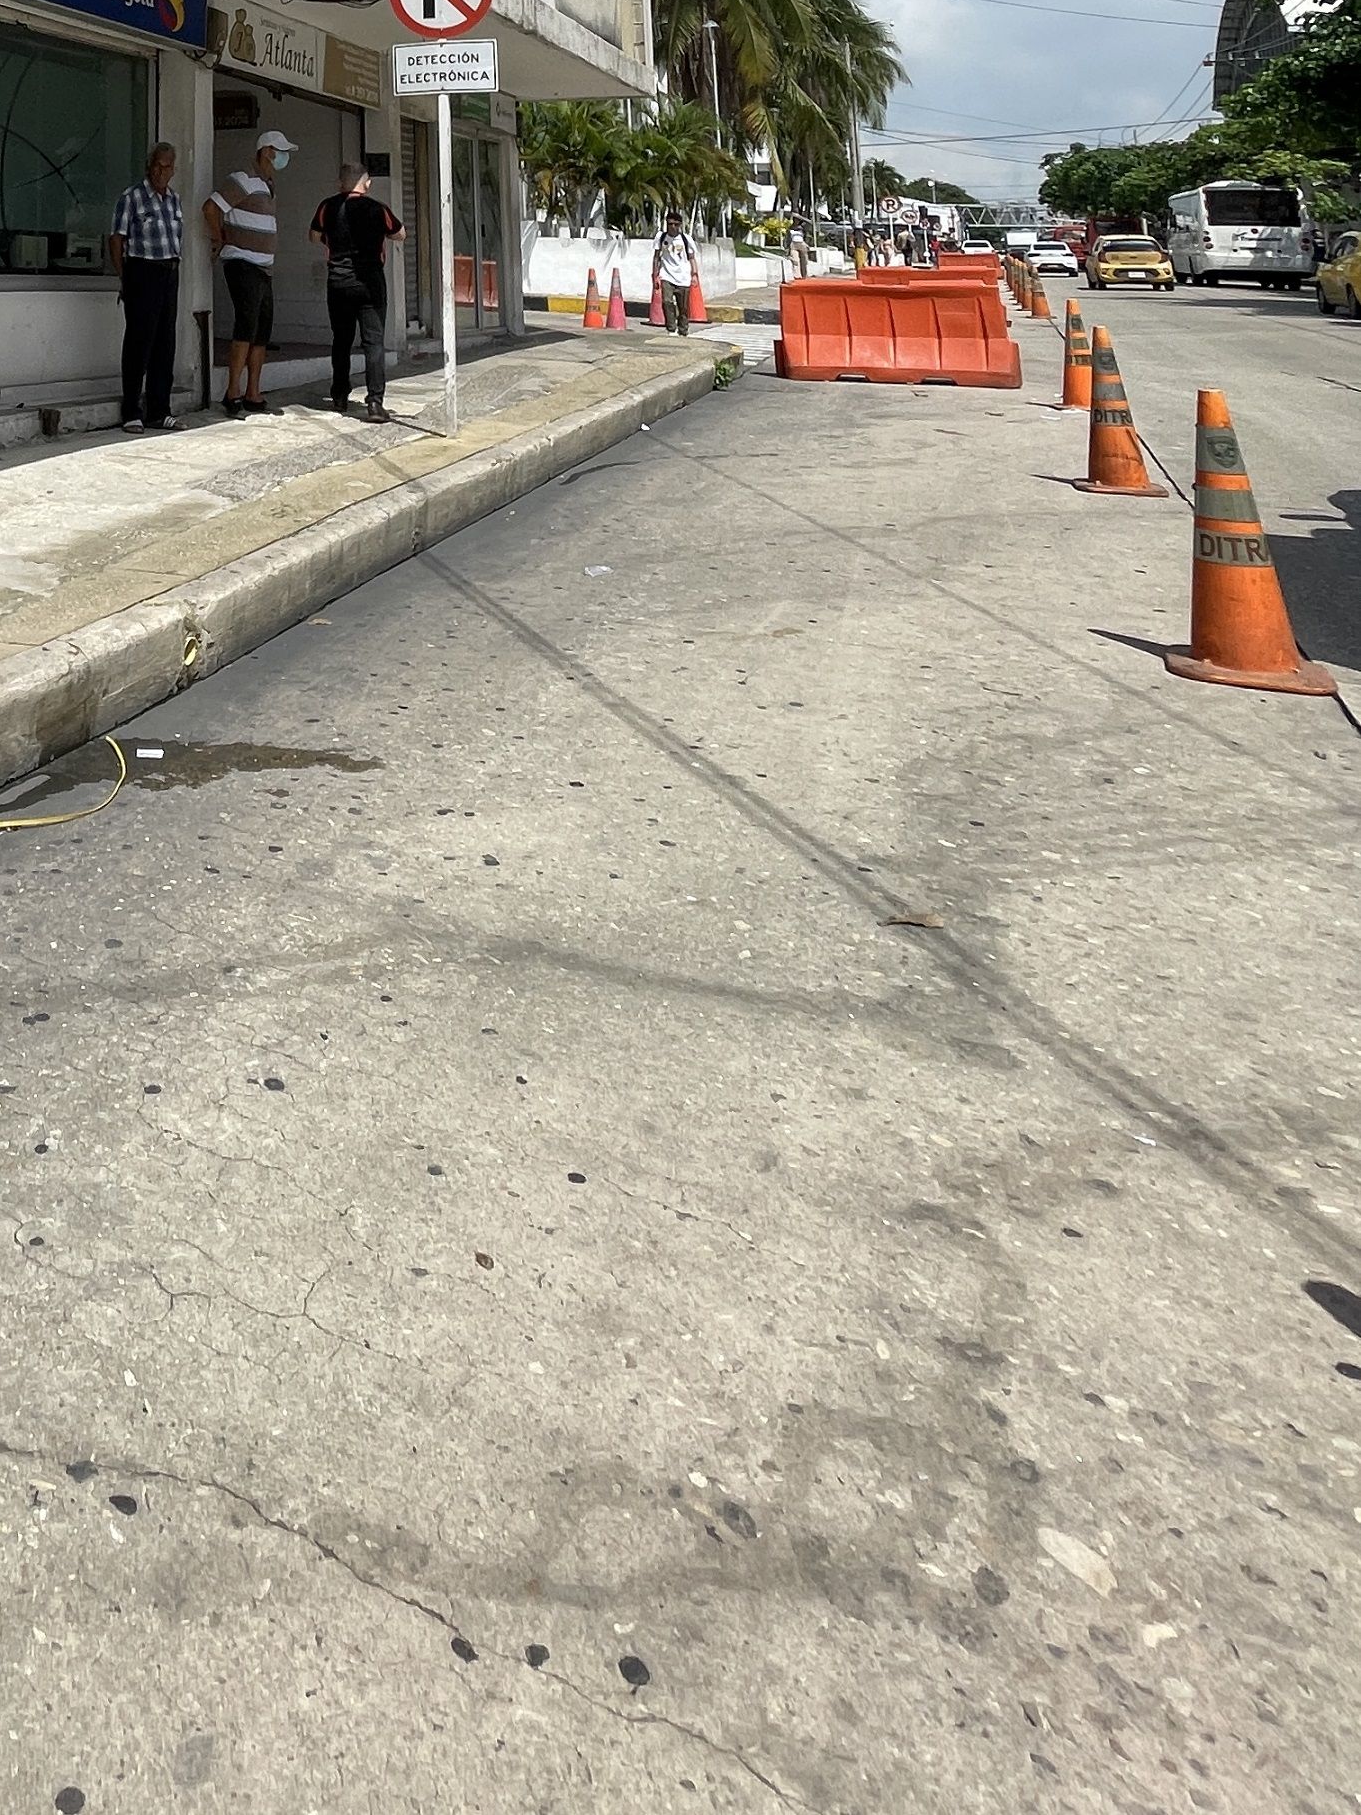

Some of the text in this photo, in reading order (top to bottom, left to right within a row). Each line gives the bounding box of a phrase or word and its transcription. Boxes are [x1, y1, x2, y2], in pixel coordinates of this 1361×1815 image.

[259, 33, 315, 78] Atlanta
[407, 51, 480, 67] DETECCIÓN
[400, 69, 490, 84] ELECTRÓNICA
[1093, 408, 1133, 425] DITR
[1199, 533, 1269, 562] DITR
